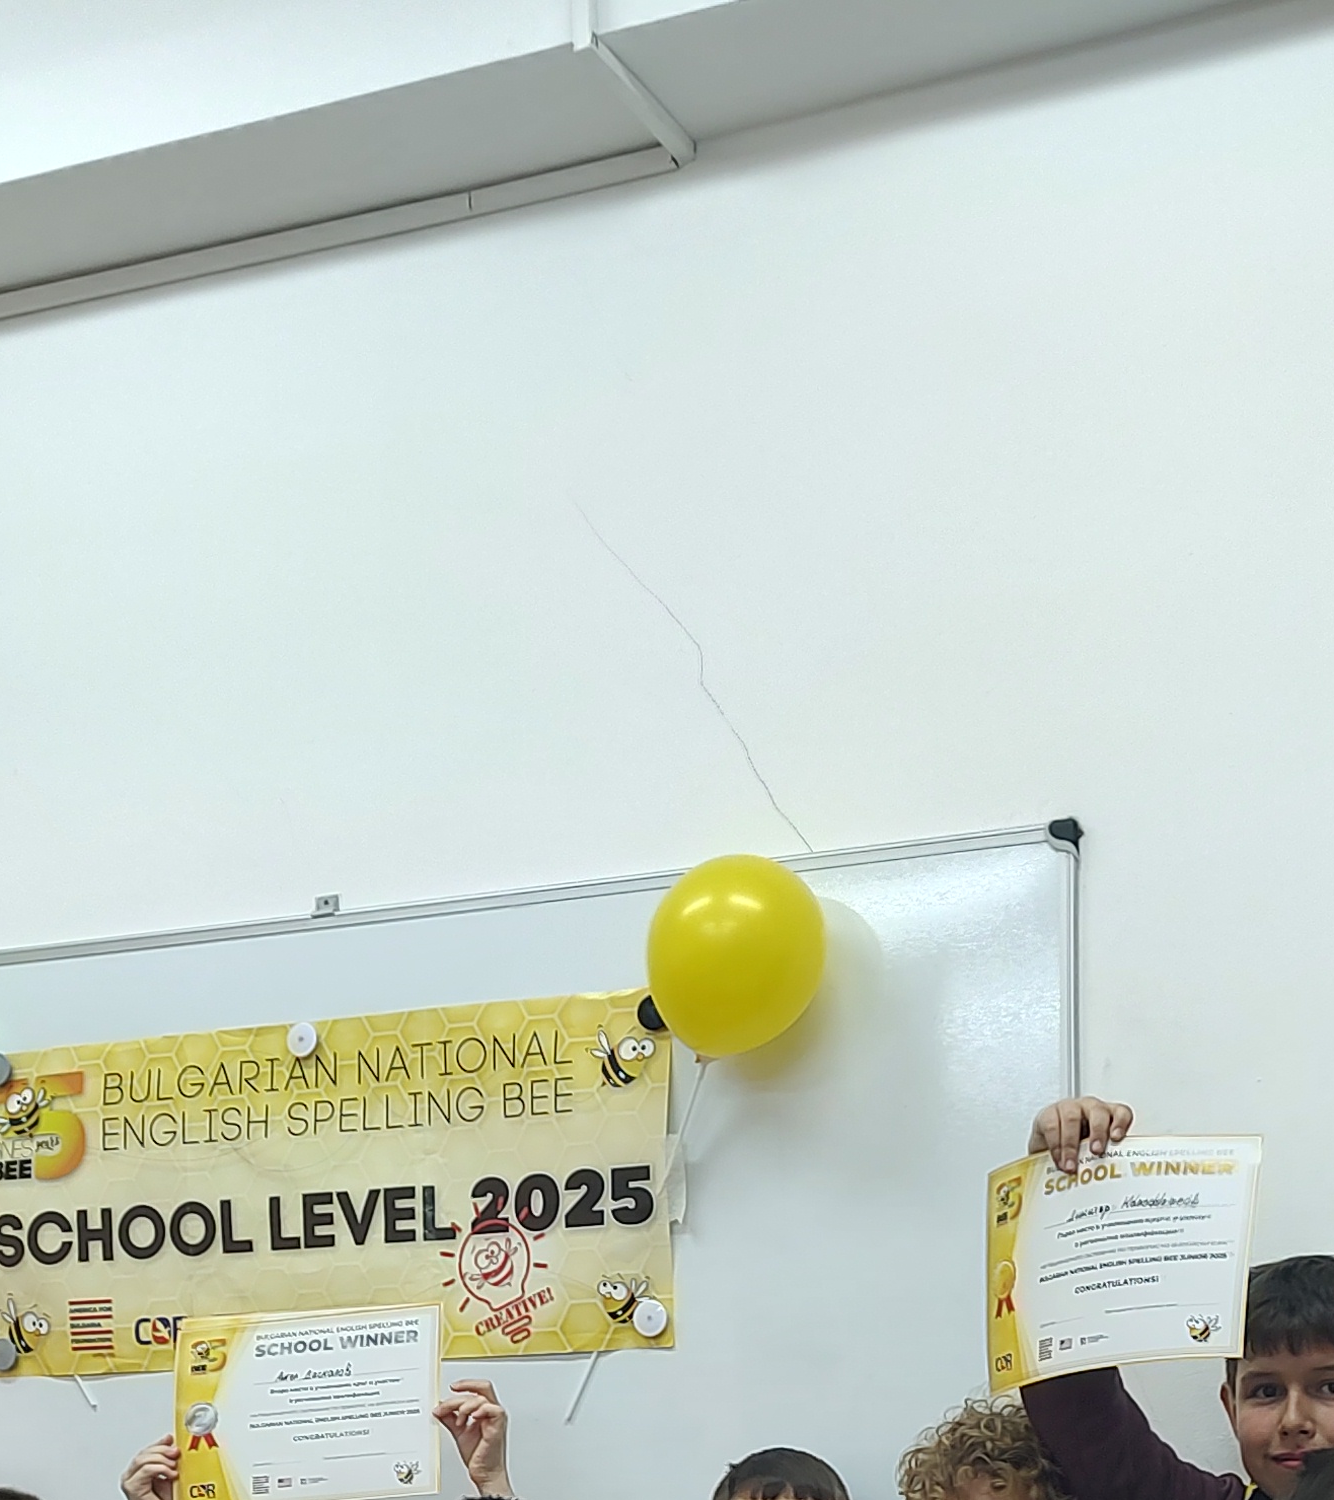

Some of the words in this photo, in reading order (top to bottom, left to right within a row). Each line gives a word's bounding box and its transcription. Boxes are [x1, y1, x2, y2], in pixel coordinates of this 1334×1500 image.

[102, 1053, 340, 1106] BULGARIAN
[356, 1029, 575, 1093] NATIONAL
[102, 1102, 271, 1151] ENGLISH
[287, 1086, 486, 1139] SPELLING
[502, 1075, 575, 1120] BEE
[269, 1184, 457, 1253] LEVEL
[470, 1164, 655, 1237] 2025
[1044, 1164, 1122, 1196] SCHOOL
[1131, 1160, 1236, 1177] WINNER
[254, 1338, 334, 1358] SCHOOL
[339, 1330, 419, 1351] WINNER
[473, 1287, 555, 1338] CREATIVE!
